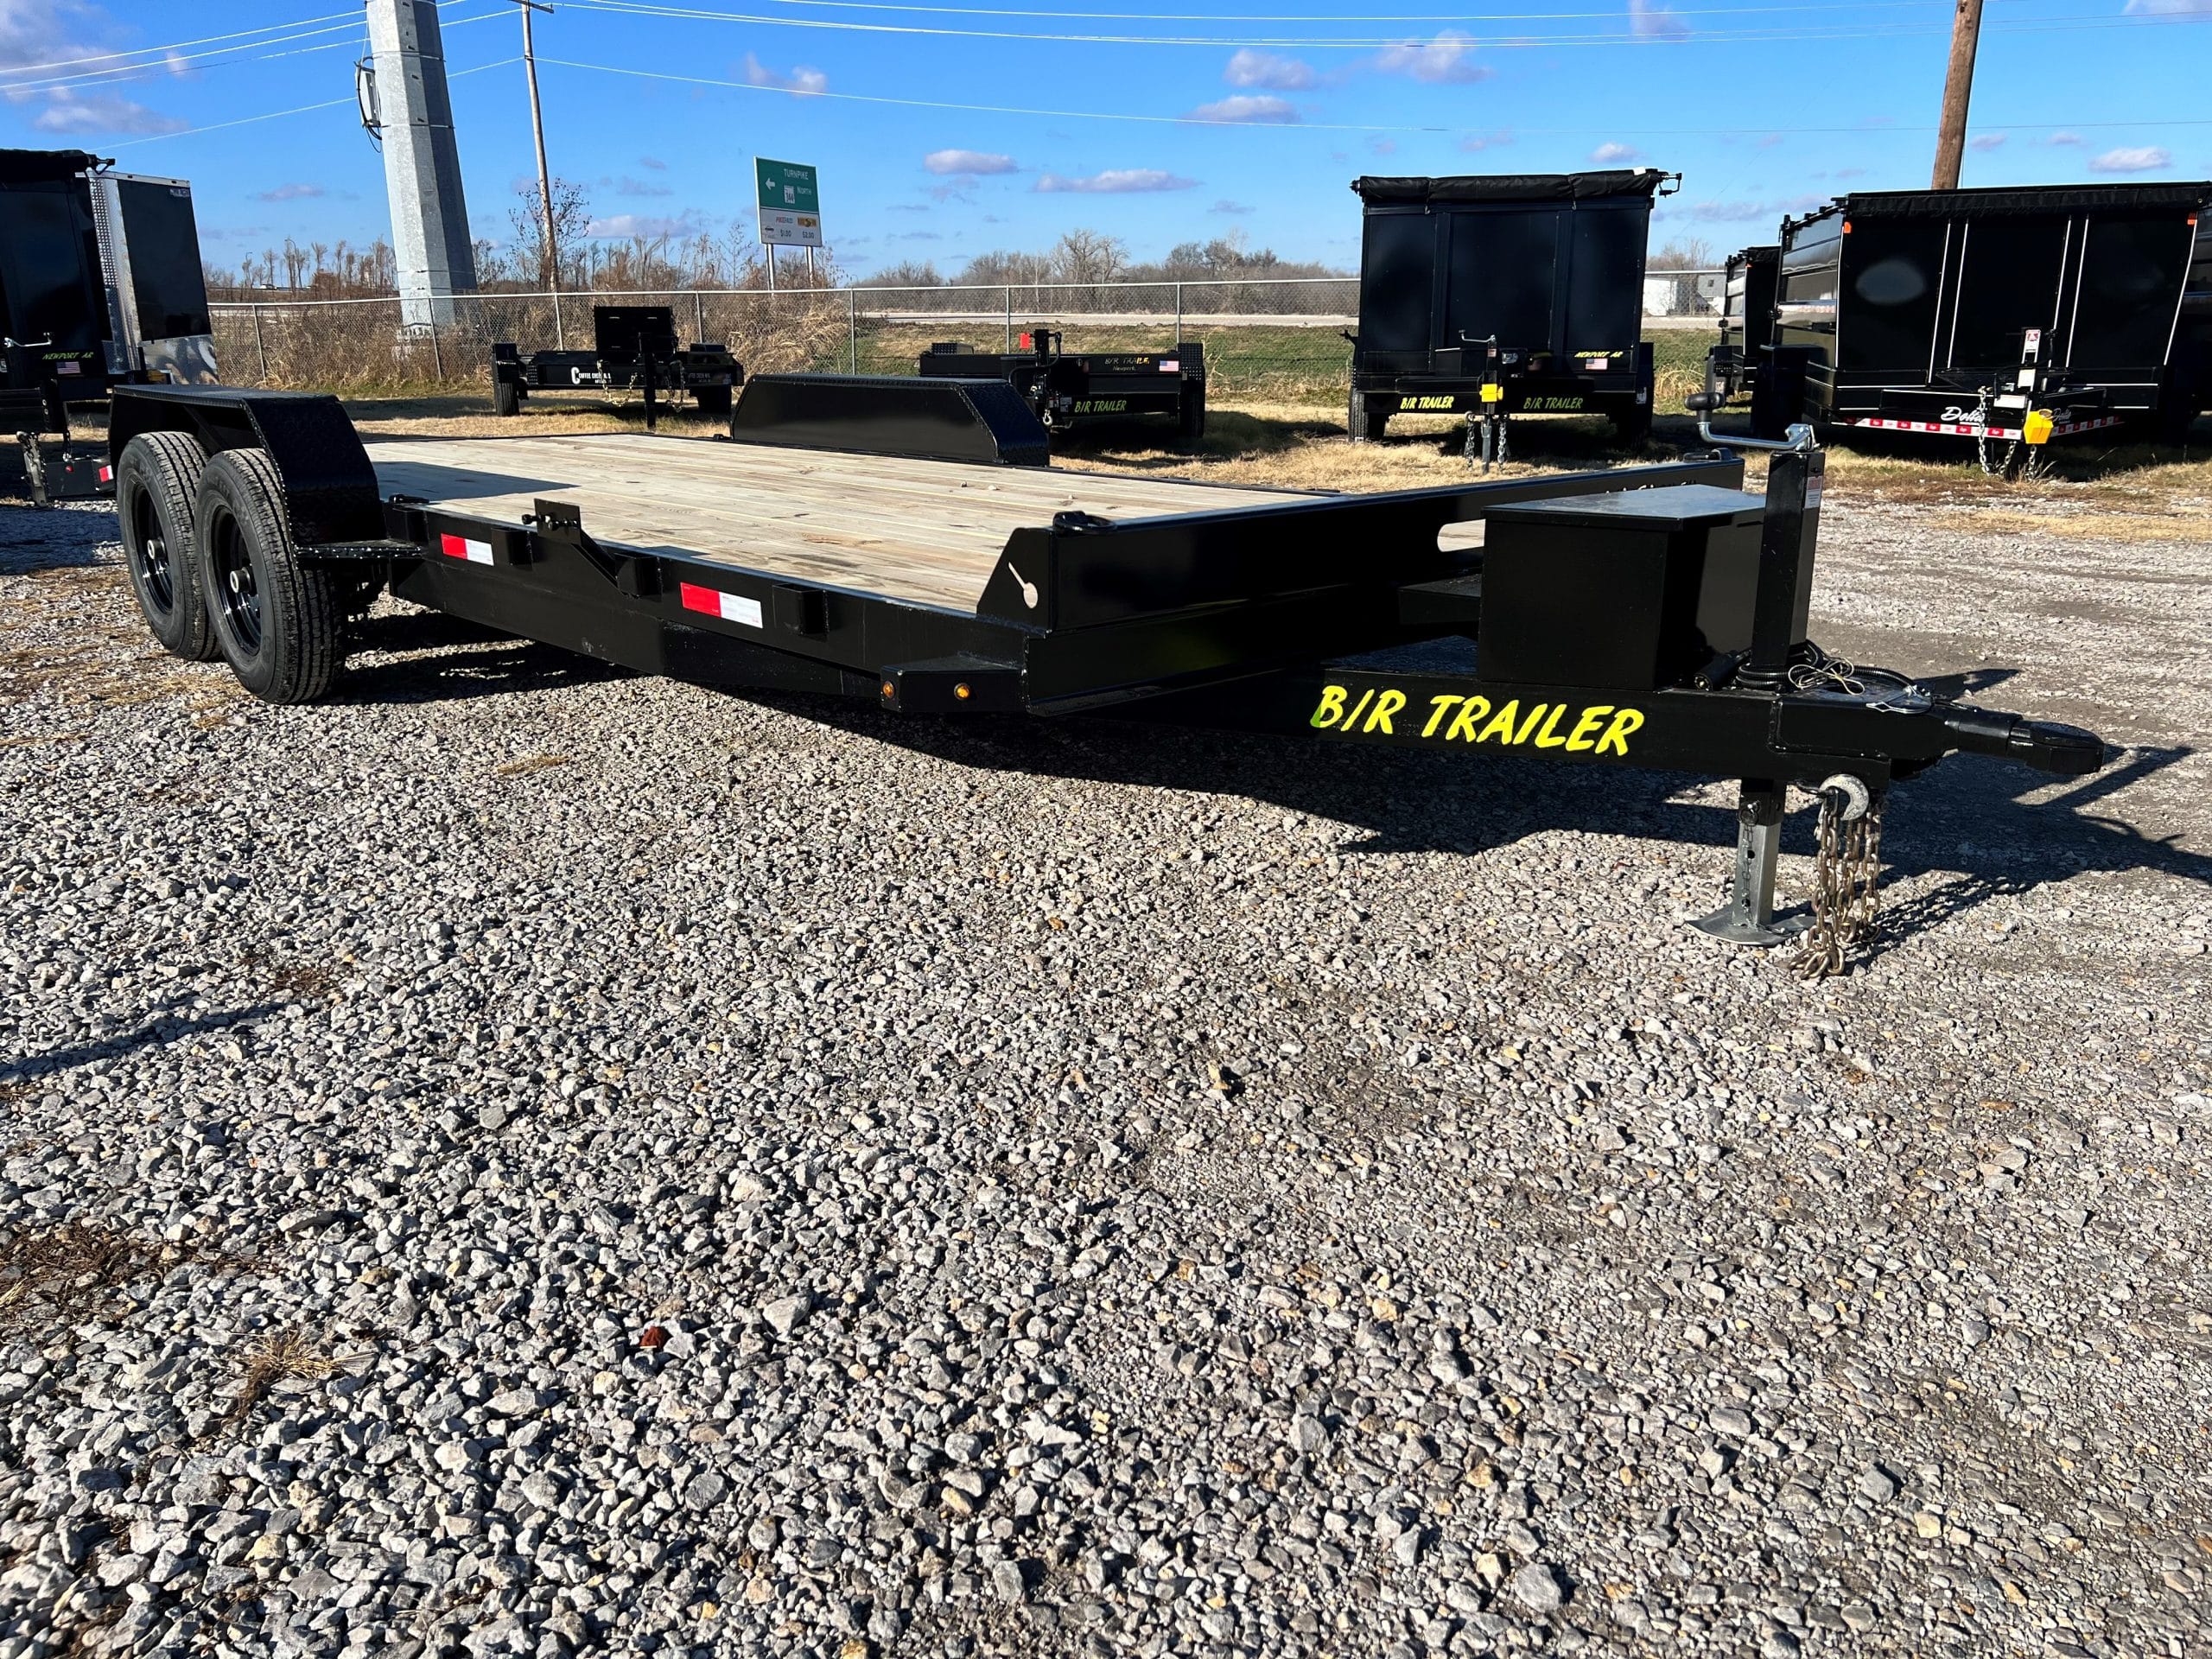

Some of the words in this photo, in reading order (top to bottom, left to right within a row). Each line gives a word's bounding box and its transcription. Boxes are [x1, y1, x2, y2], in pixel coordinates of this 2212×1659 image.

[784, 168, 809, 180] TURNPIKE
[1074, 400, 1091, 413] B/R
[1093, 399, 1127, 412] TRAILER
[1400, 397, 1417, 410] B/R
[1418, 396, 1455, 409] TRAILER
[1523, 397, 1543, 410] B/R
[1544, 397, 1584, 410] TRAILER
[1309, 684, 1408, 735] B/R
[1421, 695, 1646, 757] TRAILER
